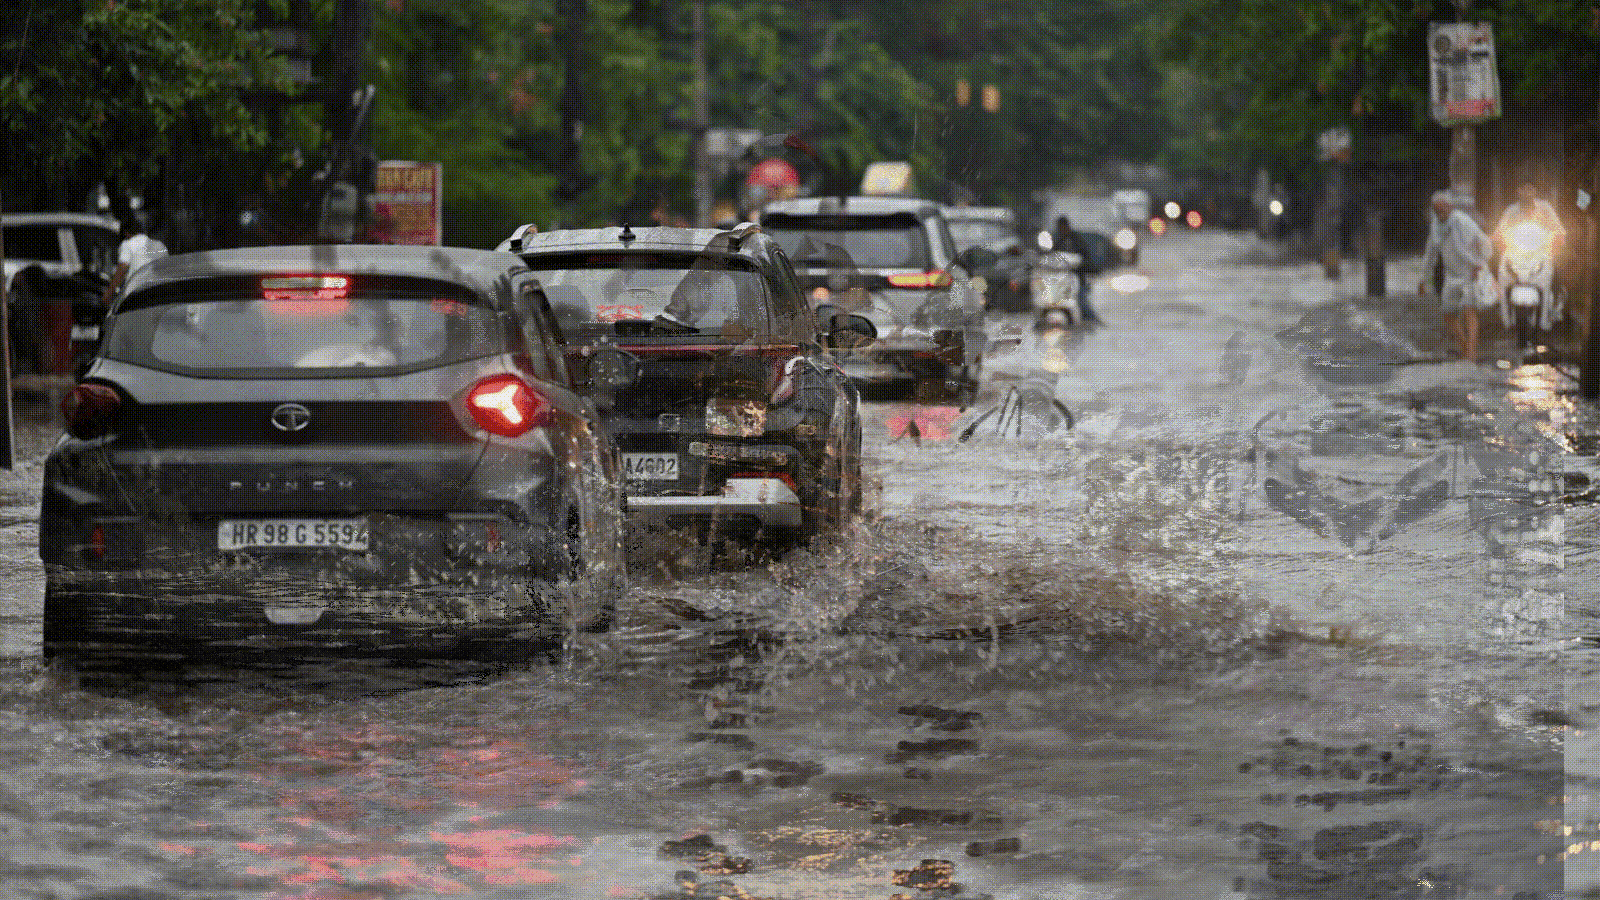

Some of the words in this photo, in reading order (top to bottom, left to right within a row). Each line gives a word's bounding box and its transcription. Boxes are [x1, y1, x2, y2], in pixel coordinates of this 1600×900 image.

[232, 524, 258, 545] HR
[263, 524, 288, 544] 98
[295, 524, 307, 544] G
[314, 524, 367, 544] 5594
